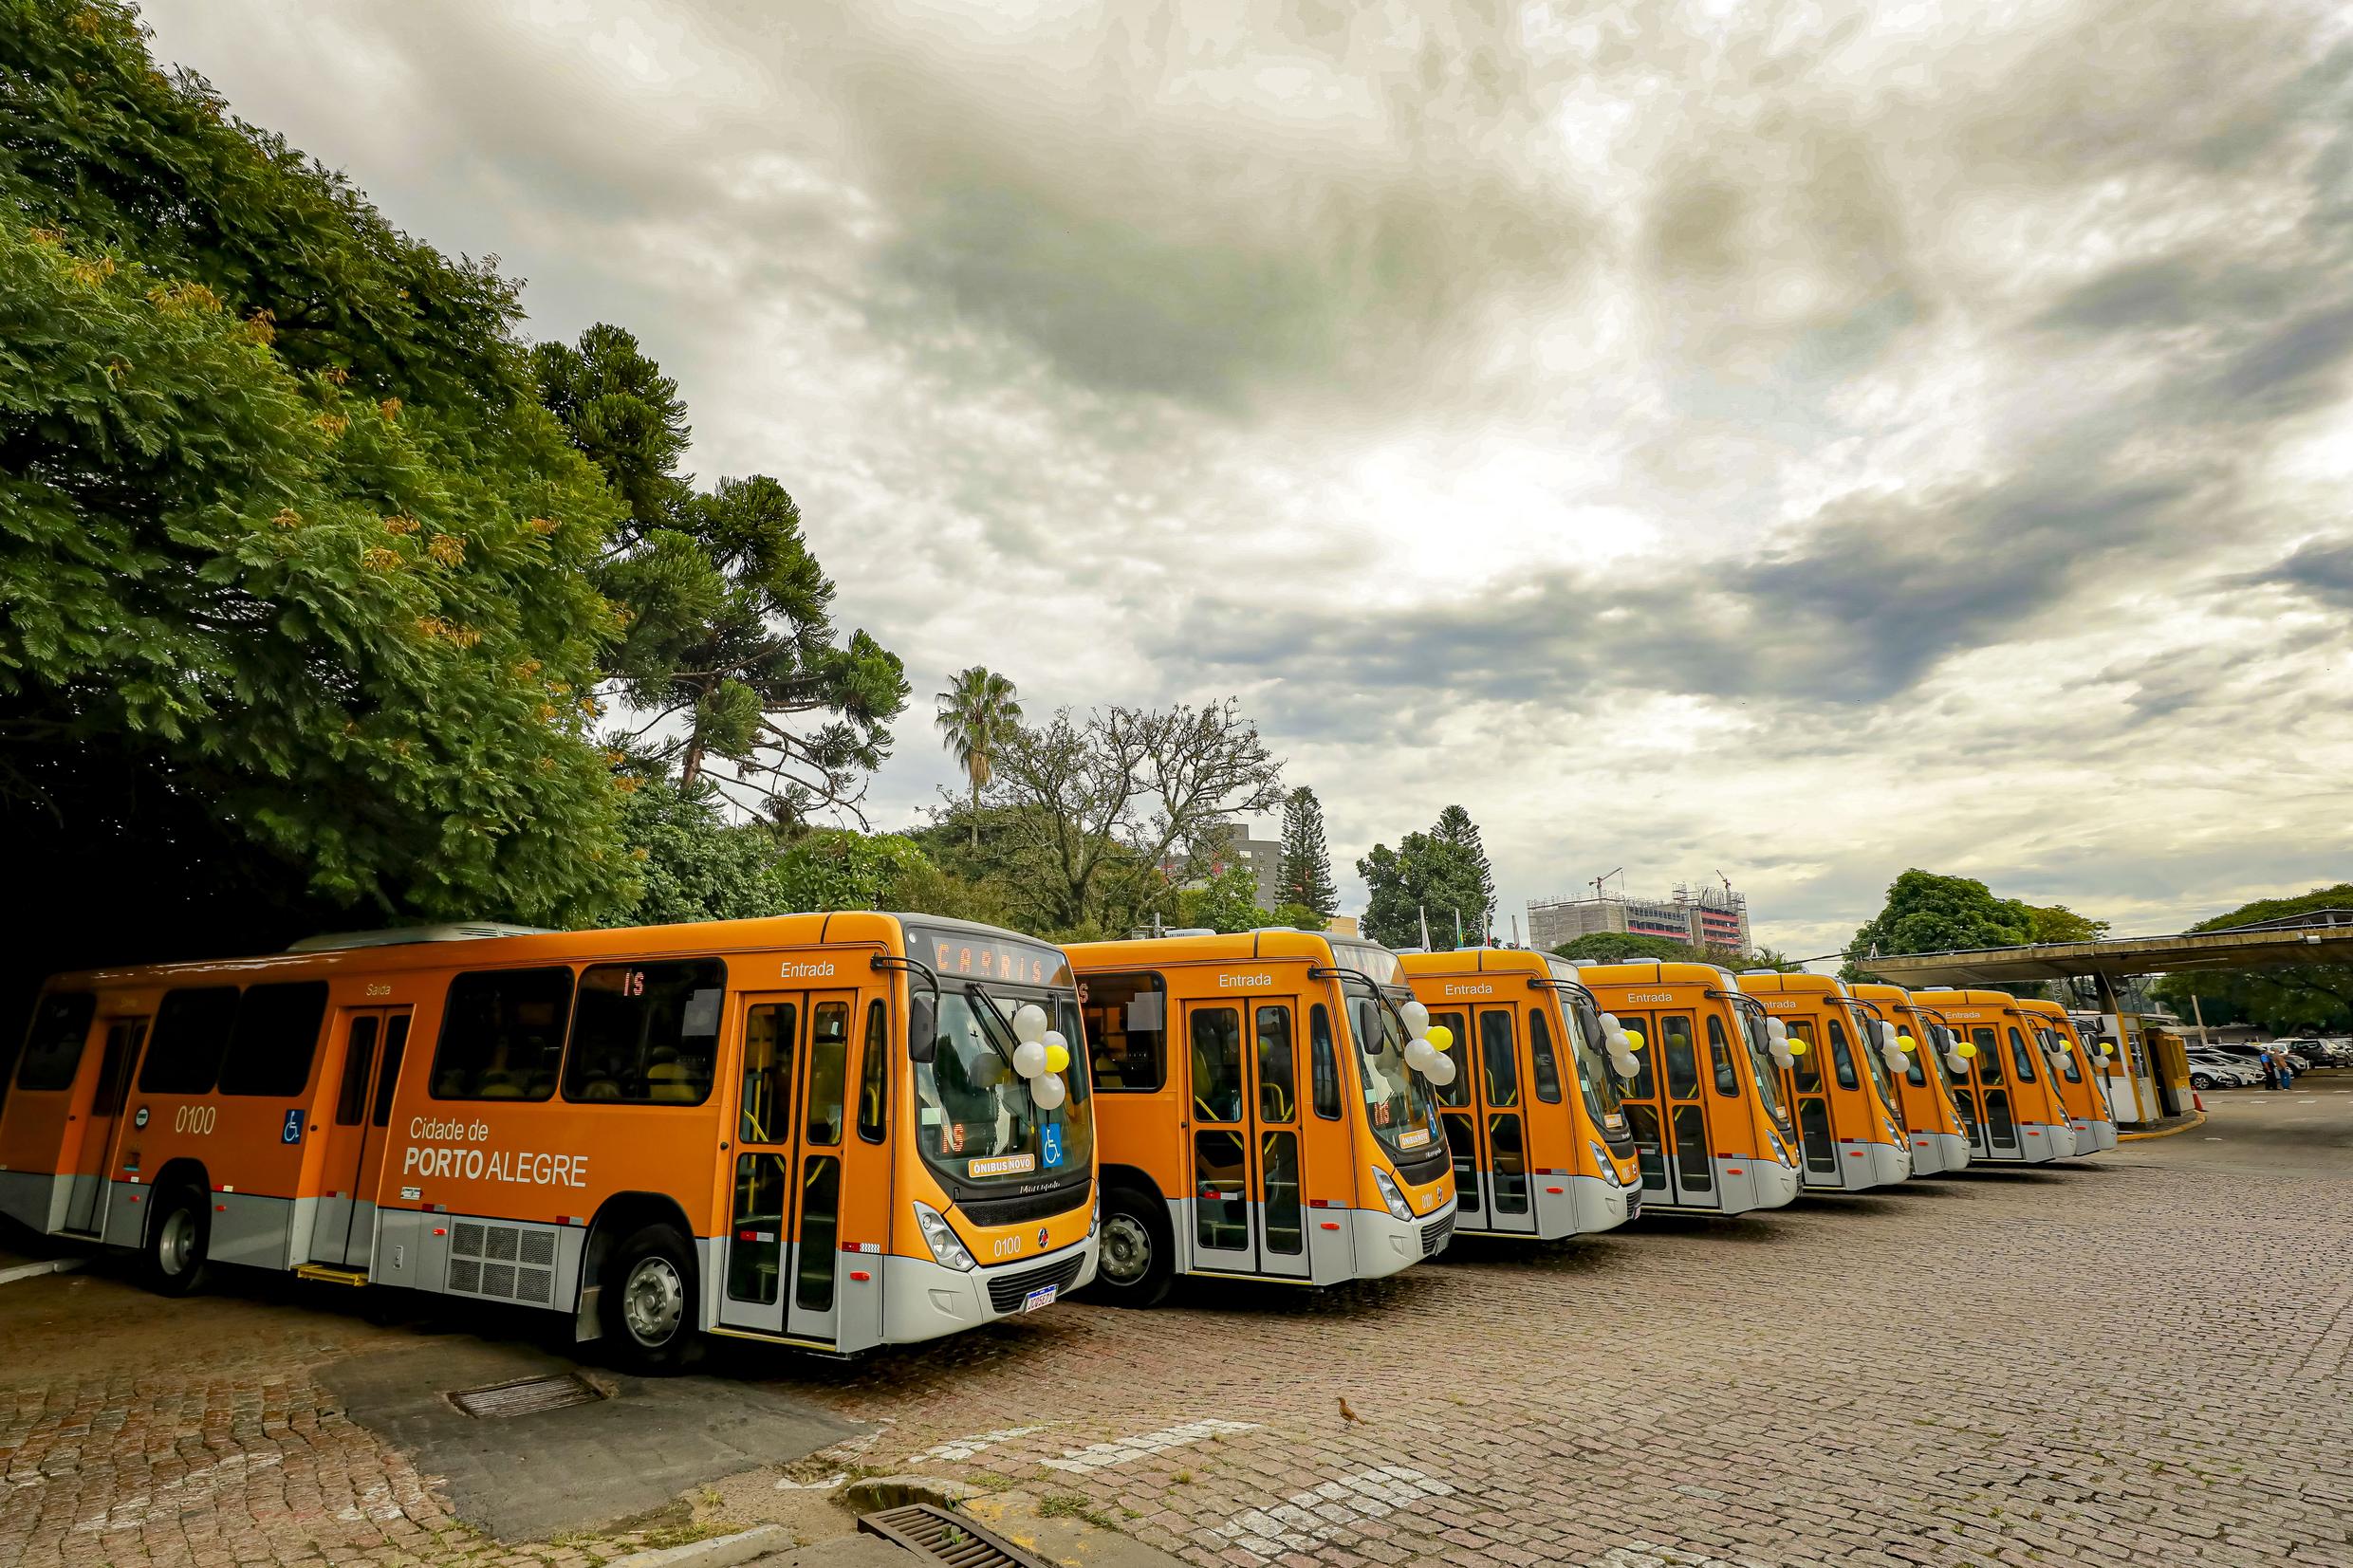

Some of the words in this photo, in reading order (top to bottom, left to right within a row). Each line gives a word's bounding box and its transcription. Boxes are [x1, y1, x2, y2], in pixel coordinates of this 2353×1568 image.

[781, 961, 835, 978] Entrada
[1218, 972, 1272, 987] Entrada
[1444, 983, 1493, 996] Entrada
[1627, 992, 1673, 1004] Entrada
[1763, 1000, 1797, 1009] ntrada
[176, 1105, 216, 1134] 0100
[410, 1116, 464, 1140] Cidade
[468, 1118, 489, 1141] de
[403, 1147, 484, 1179] PORTO
[485, 1151, 588, 1188] ALEGRE
[973, 1160, 1008, 1174] ÔNIBUS
[1009, 1157, 1031, 1170] NOVO
[994, 1235, 1021, 1257] 0100
